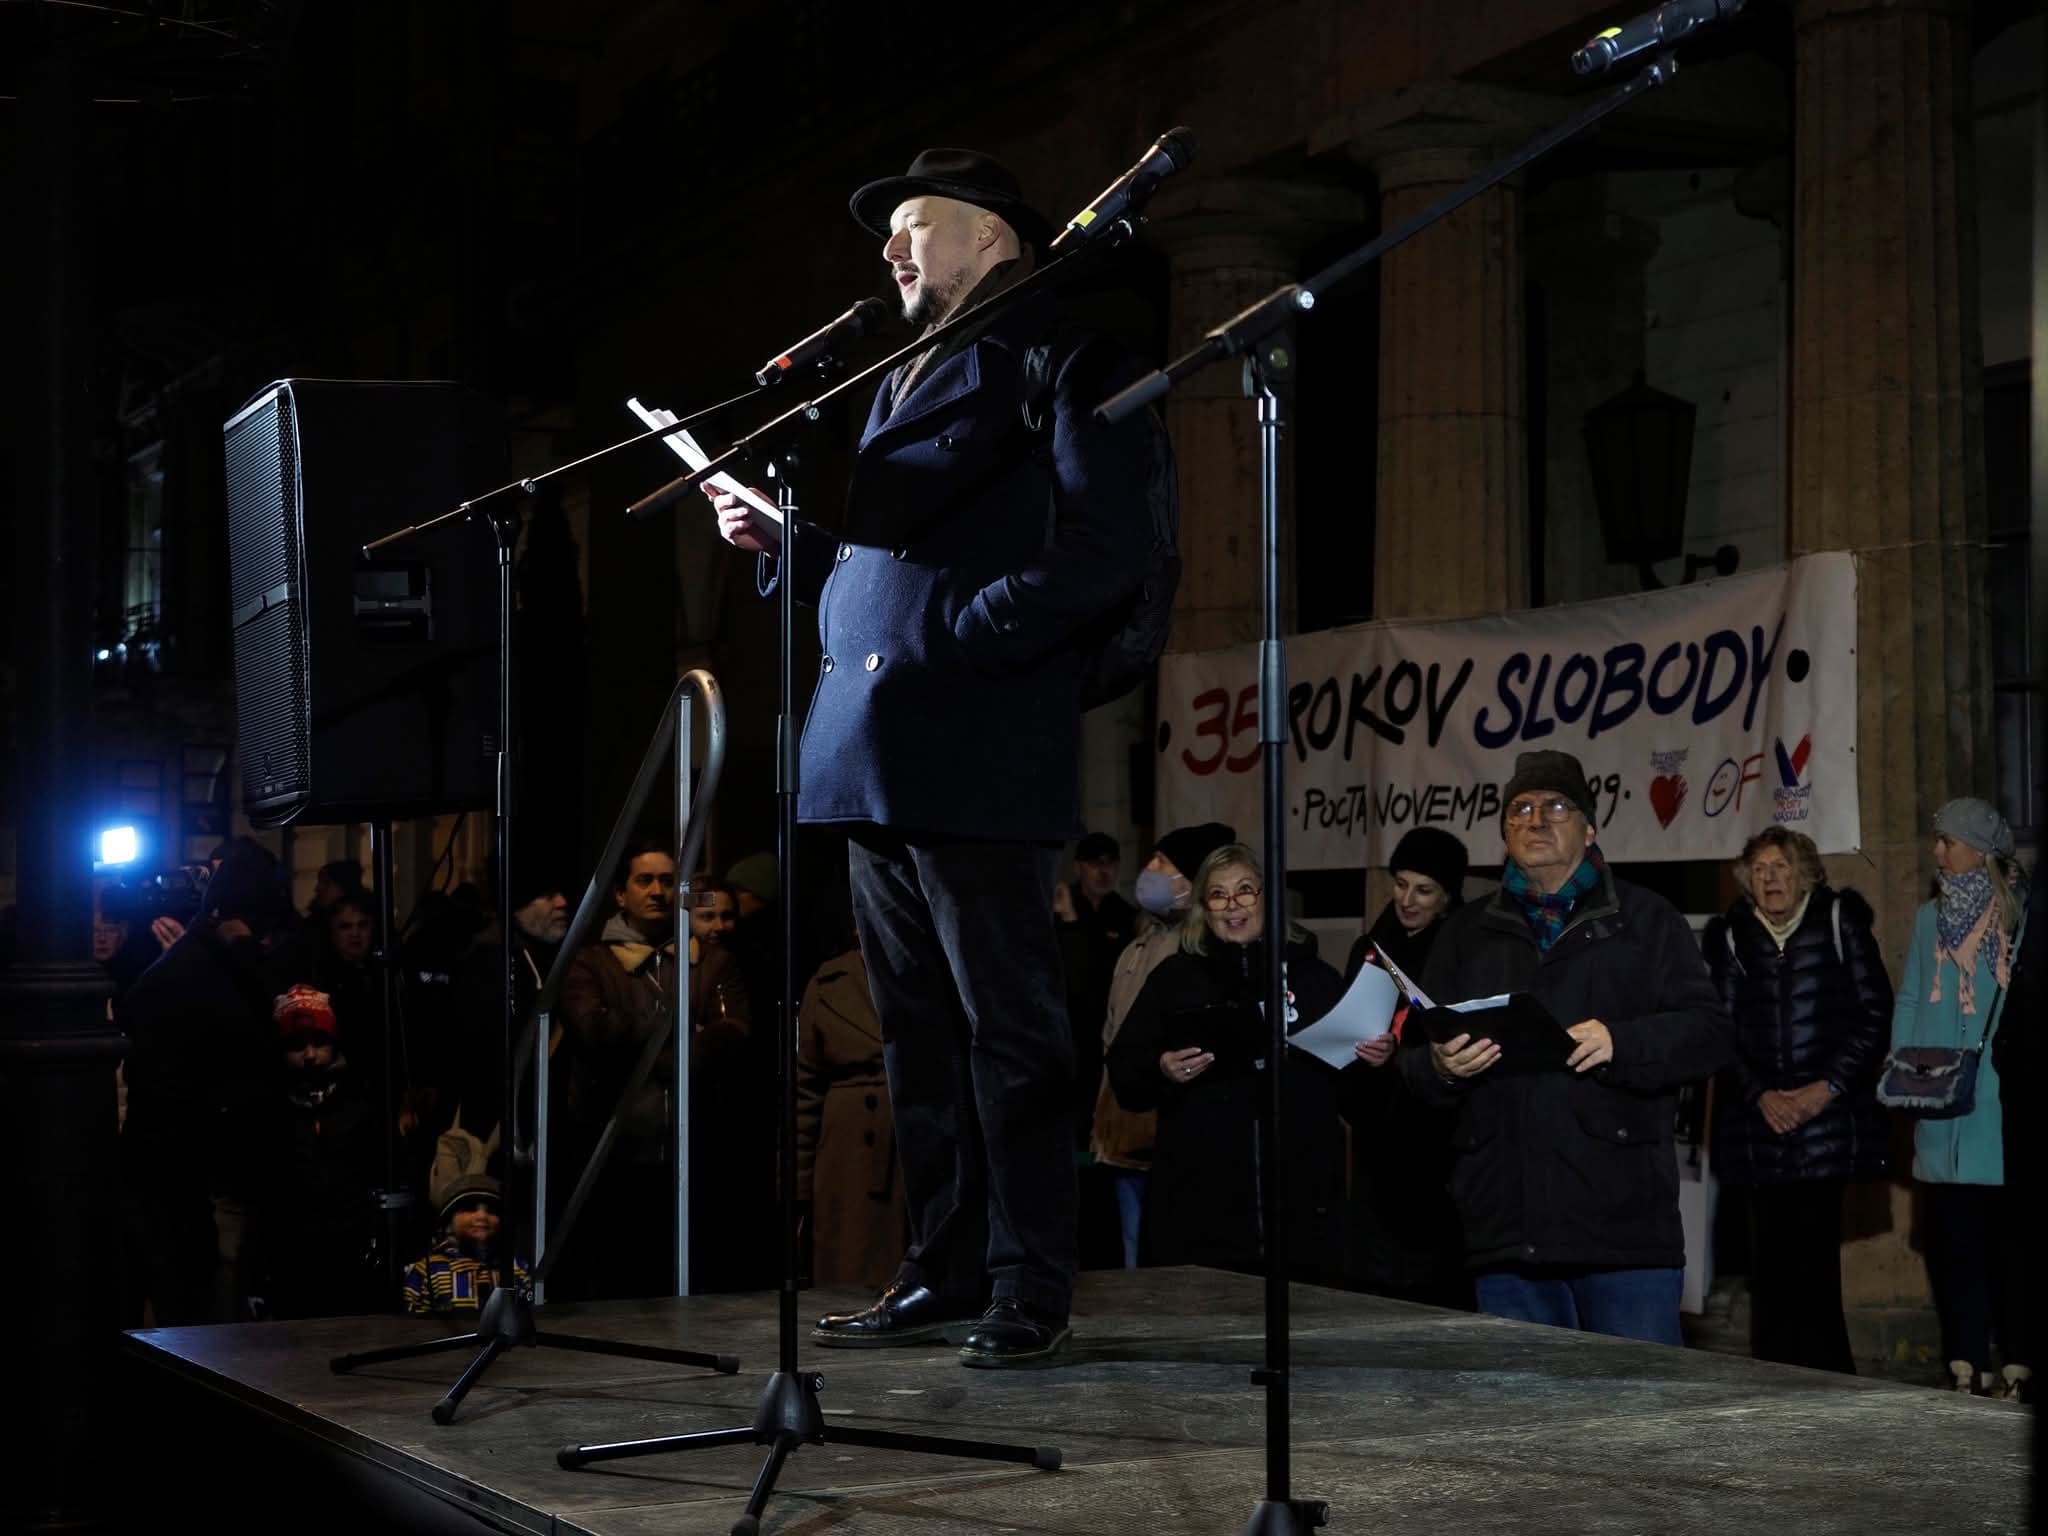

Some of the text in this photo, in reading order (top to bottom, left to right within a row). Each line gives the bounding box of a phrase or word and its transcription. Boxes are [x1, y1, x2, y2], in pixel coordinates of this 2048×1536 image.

[1184, 684, 1261, 776] 35
[1475, 614, 1784, 749] SLOBODY
[1374, 784, 1500, 830] NOVEMB
